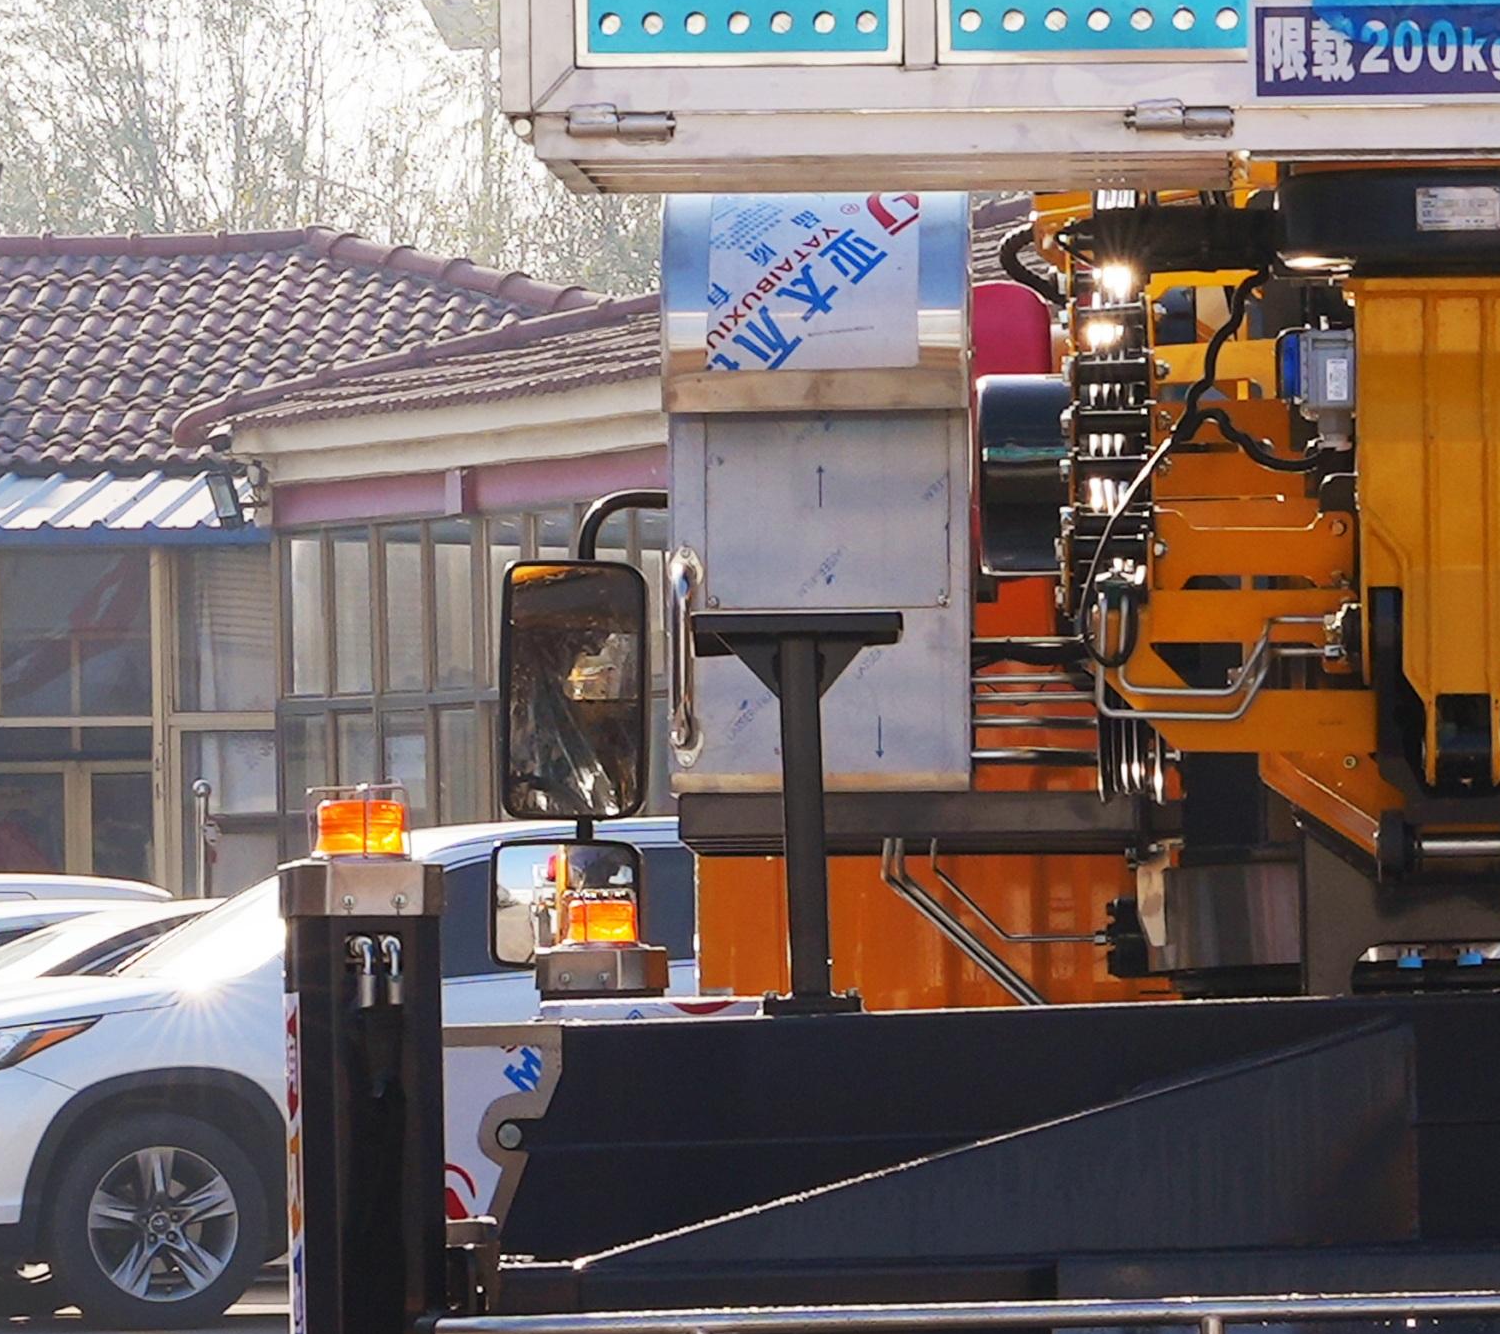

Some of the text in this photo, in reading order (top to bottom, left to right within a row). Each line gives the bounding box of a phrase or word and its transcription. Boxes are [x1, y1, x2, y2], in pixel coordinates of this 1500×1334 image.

[705, 227, 841, 359] YATAIBUXIU
[706, 227, 889, 371] 亚太不
